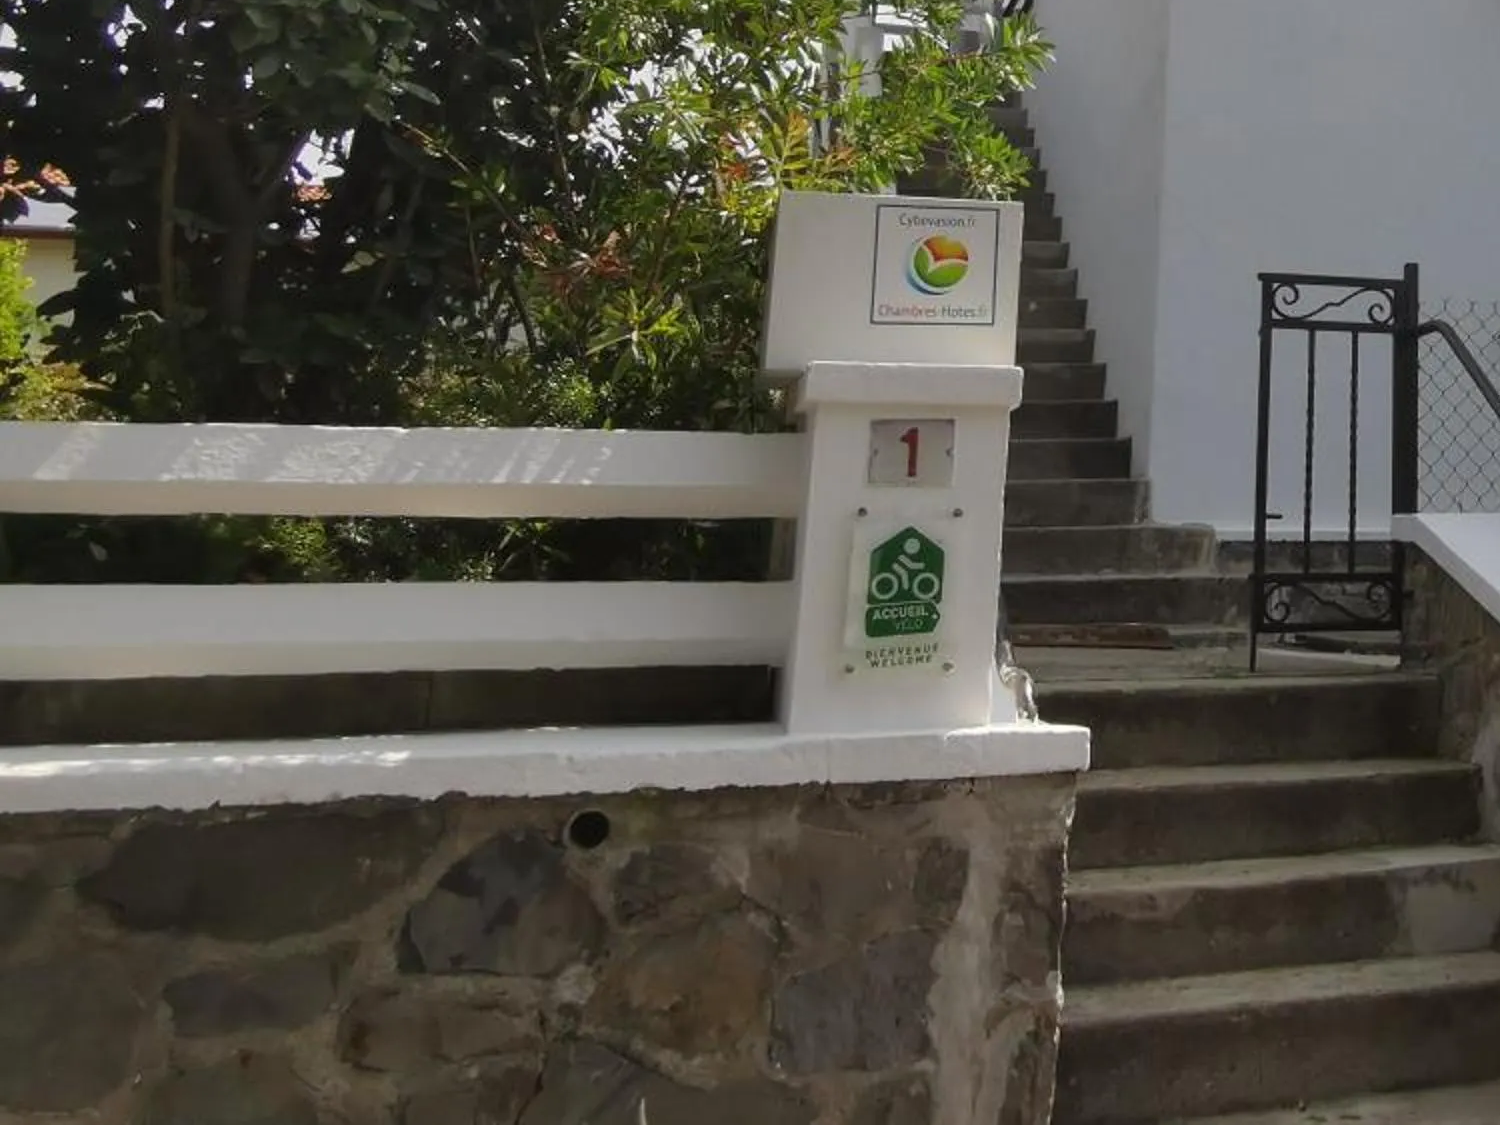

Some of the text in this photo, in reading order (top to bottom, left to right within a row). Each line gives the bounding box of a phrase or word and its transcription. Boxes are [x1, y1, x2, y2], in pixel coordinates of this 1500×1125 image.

[900, 427, 920, 477] 1
[872, 605, 929, 620] ACCUEIL
[870, 654, 932, 668] WELCOME
